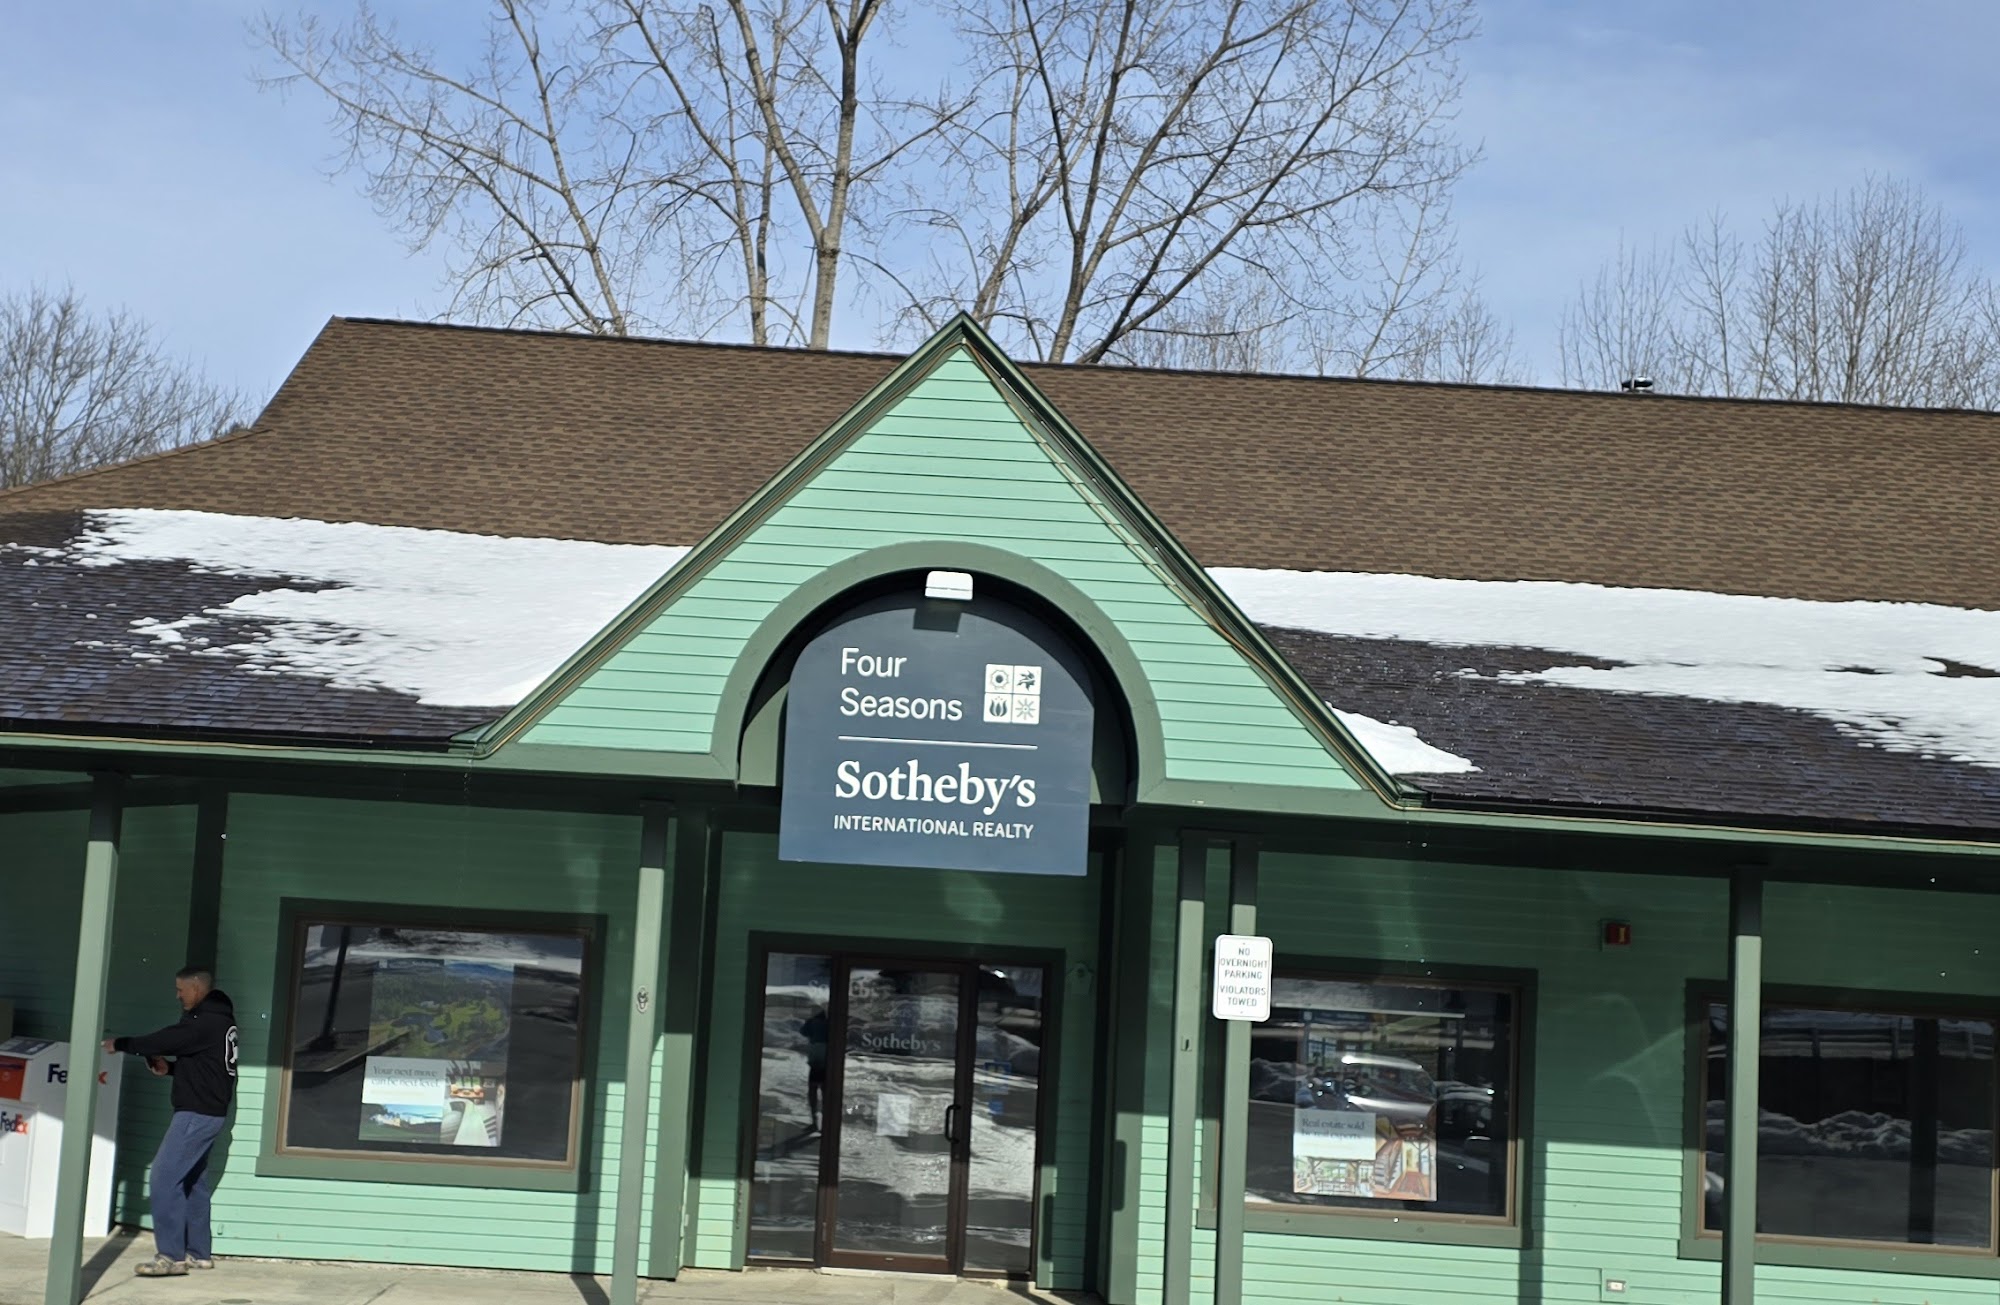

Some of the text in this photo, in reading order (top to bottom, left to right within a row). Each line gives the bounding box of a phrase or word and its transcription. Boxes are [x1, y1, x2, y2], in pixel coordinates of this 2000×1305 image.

[841, 647, 907, 678] Four
[839, 687, 963, 721] Seasons
[835, 759, 1036, 815] Sotheby's
[833, 814, 1034, 839] INTERNATIONAL REALTY
[1238, 947, 1251, 956] NO
[1220, 958, 1268, 968] OVERNIGHT
[1224, 969, 1263, 980] PARKING
[1220, 985, 1267, 996] VIOLATORS
[1227, 997, 1257, 1007] TOWED
[860, 1032, 941, 1054] Sotheby's
[0, 1111, 28, 1135] FedEx
